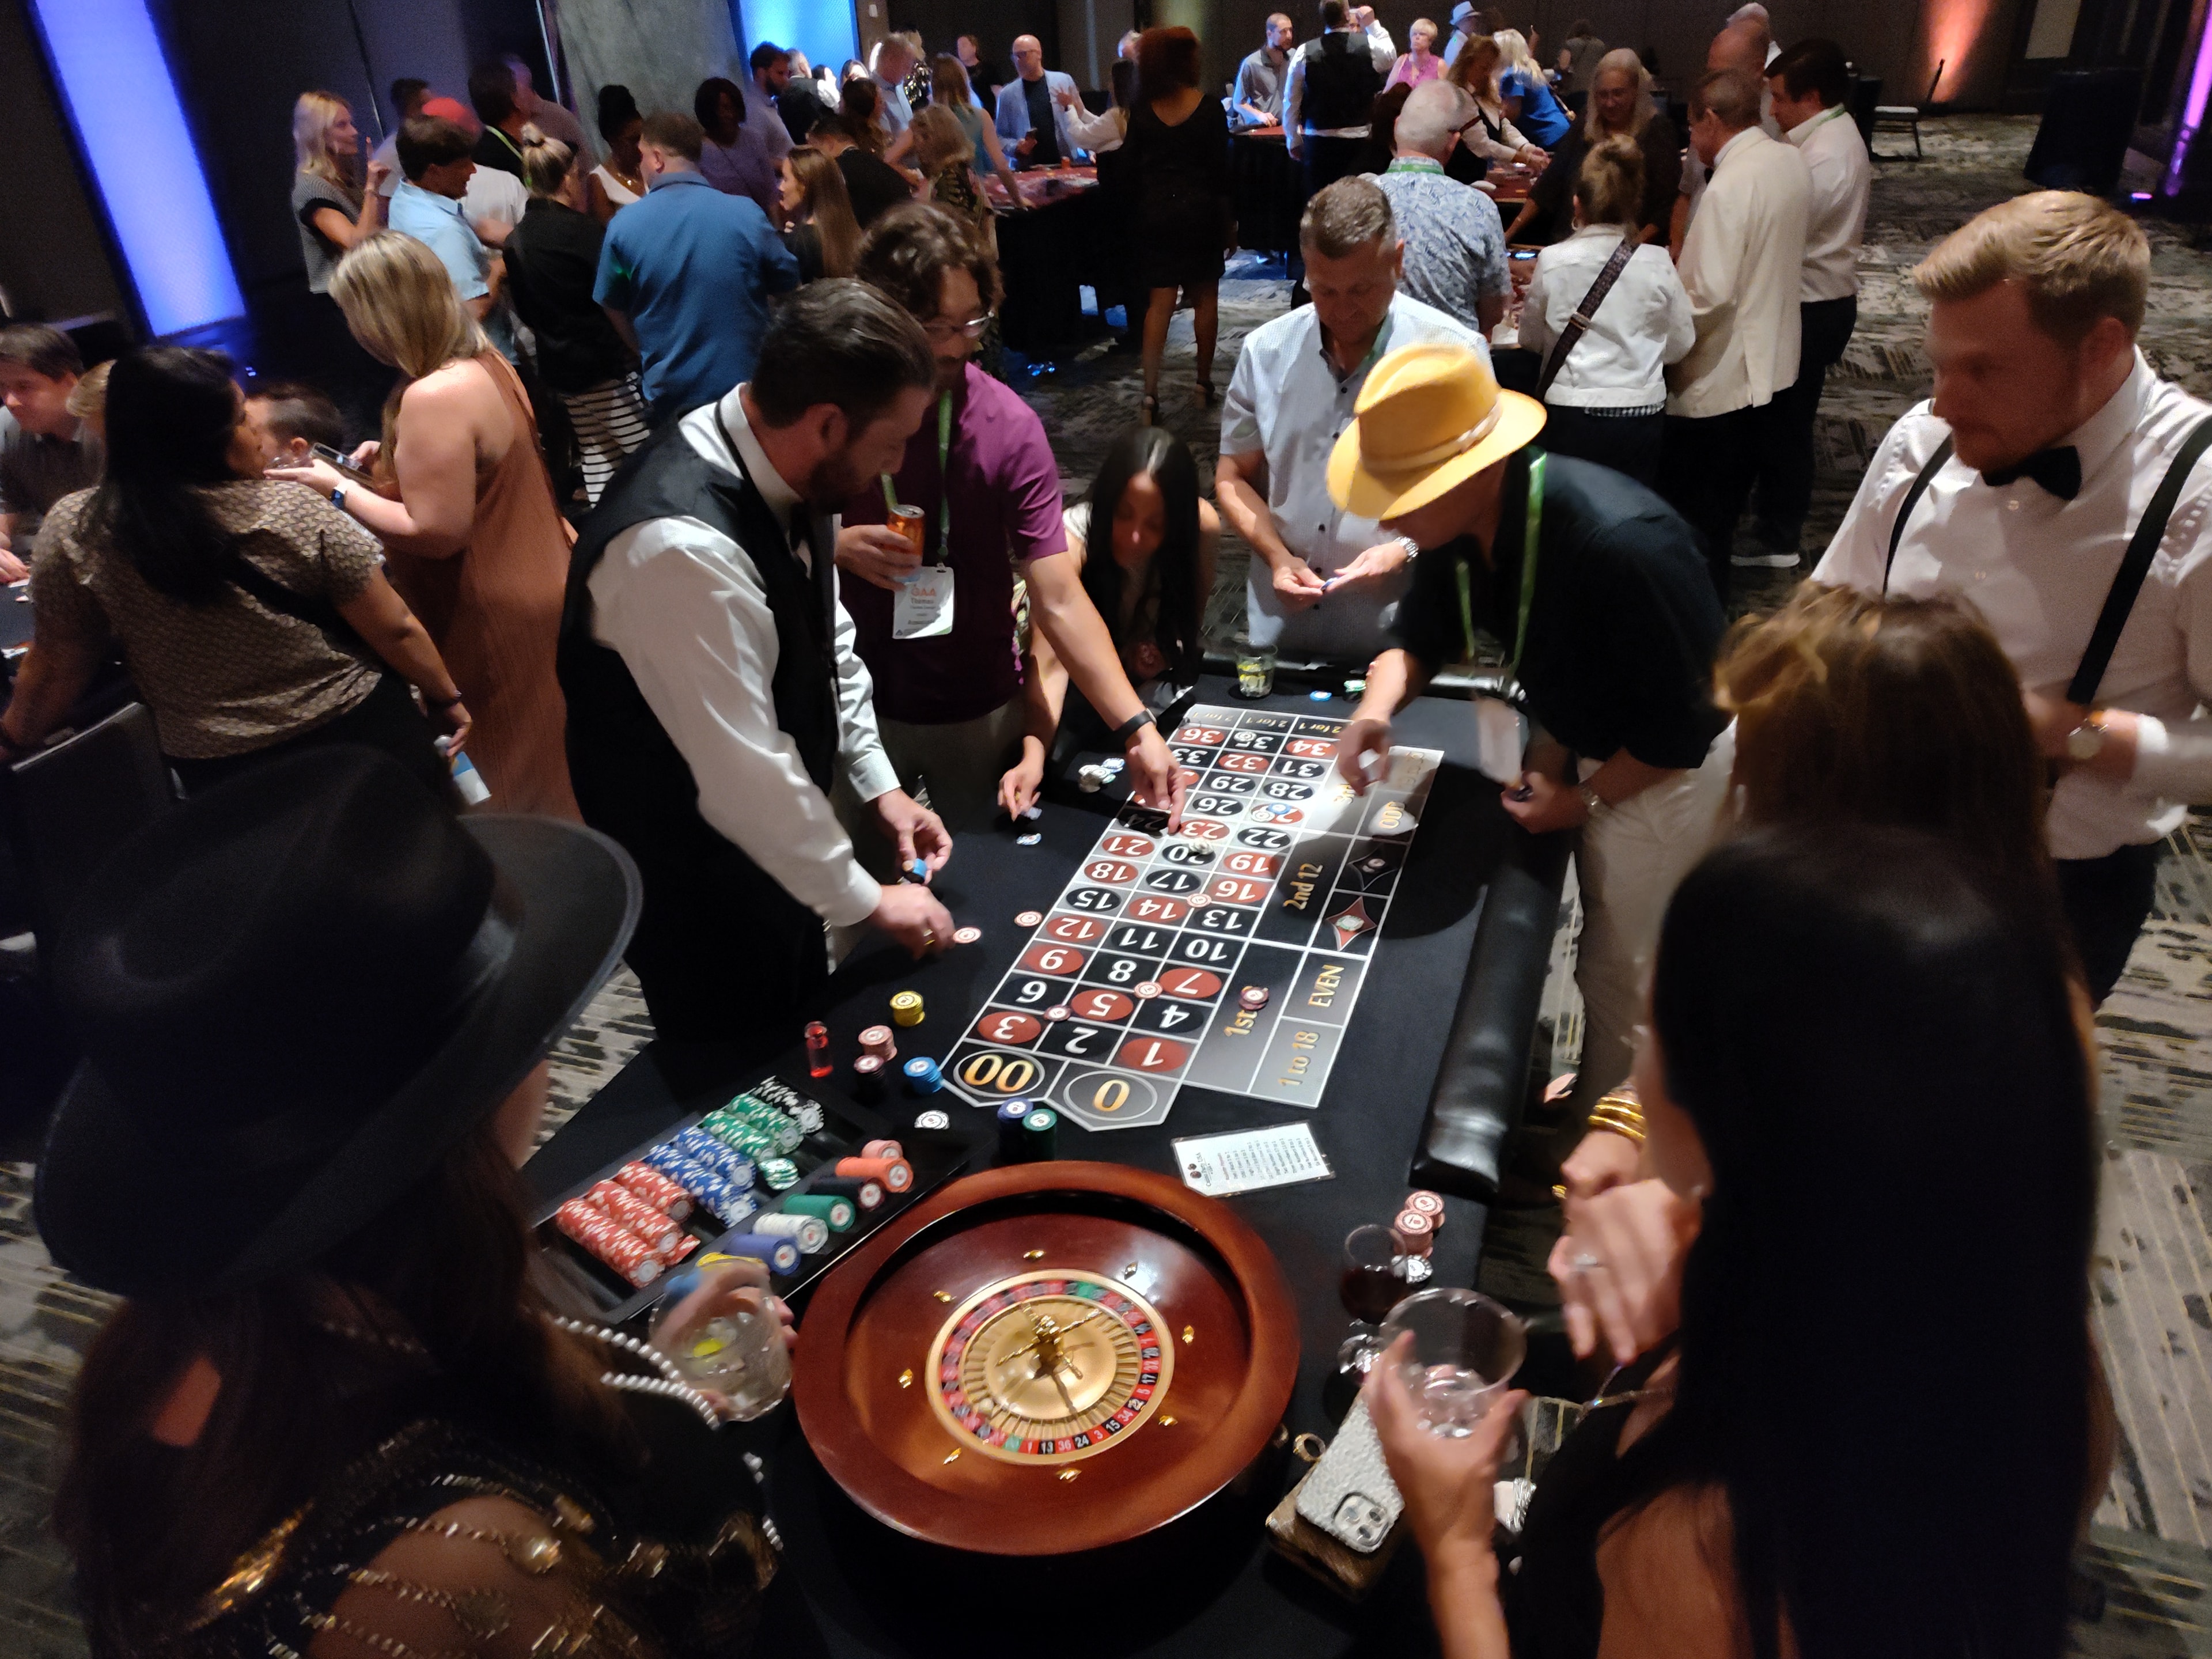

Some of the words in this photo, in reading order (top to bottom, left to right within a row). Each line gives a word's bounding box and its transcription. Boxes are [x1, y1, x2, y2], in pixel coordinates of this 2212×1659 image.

[1254, 716, 1276, 726] for
[1307, 722, 1330, 732] for
[1182, 729, 1221, 744] 36
[1174, 748, 1208, 764] 33
[1292, 740, 1331, 756] 34
[1225, 754, 1263, 770] 32
[1281, 761, 1320, 777] 31
[1211, 777, 1251, 793] 29
[1270, 783, 1310, 800] 28
[1198, 798, 1238, 815] 26
[1184, 821, 1224, 839] 23
[1244, 829, 1286, 847] 22
[1107, 837, 1149, 855] 21
[1092, 863, 1128, 881] 18
[1230, 854, 1269, 873] 19
[1298, 863, 1323, 878] 12
[1150, 872, 1190, 891] 17
[1215, 881, 1255, 901] 16
[1074, 891, 1113, 910] 15
[1282, 881, 1315, 910] 2nd
[1138, 899, 1177, 919] 14
[1055, 918, 1094, 940] 12
[1203, 910, 1243, 930] 13
[1119, 927, 1159, 950] 11
[1039, 949, 1069, 969] 9
[1184, 939, 1228, 961] 10
[1108, 960, 1137, 982] 8
[1016, 981, 1047, 1003] 6
[1175, 972, 1203, 995] 7
[1308, 964, 1345, 1007] EVEN
[1088, 994, 1119, 1017] 5
[1159, 1004, 1191, 1029] 4
[1224, 1009, 1258, 1037] 1st
[993, 1016, 1027, 1040] 3
[1065, 1027, 1099, 1054] 2
[1292, 1031, 1320, 1050] 18
[1140, 1041, 1165, 1067] 1
[963, 1055, 1035, 1092] 00
[1287, 1056, 1310, 1074] to
[1278, 1077, 1302, 1086] 1
[1092, 1079, 1130, 1112] 0
[1105, 1419, 1120, 1432] 15
[1118, 1410, 1133, 1422] 34
[1075, 1435, 1089, 1448] 24
[1094, 1430, 1103, 1440] 3
[1041, 1441, 1054, 1453] 13
